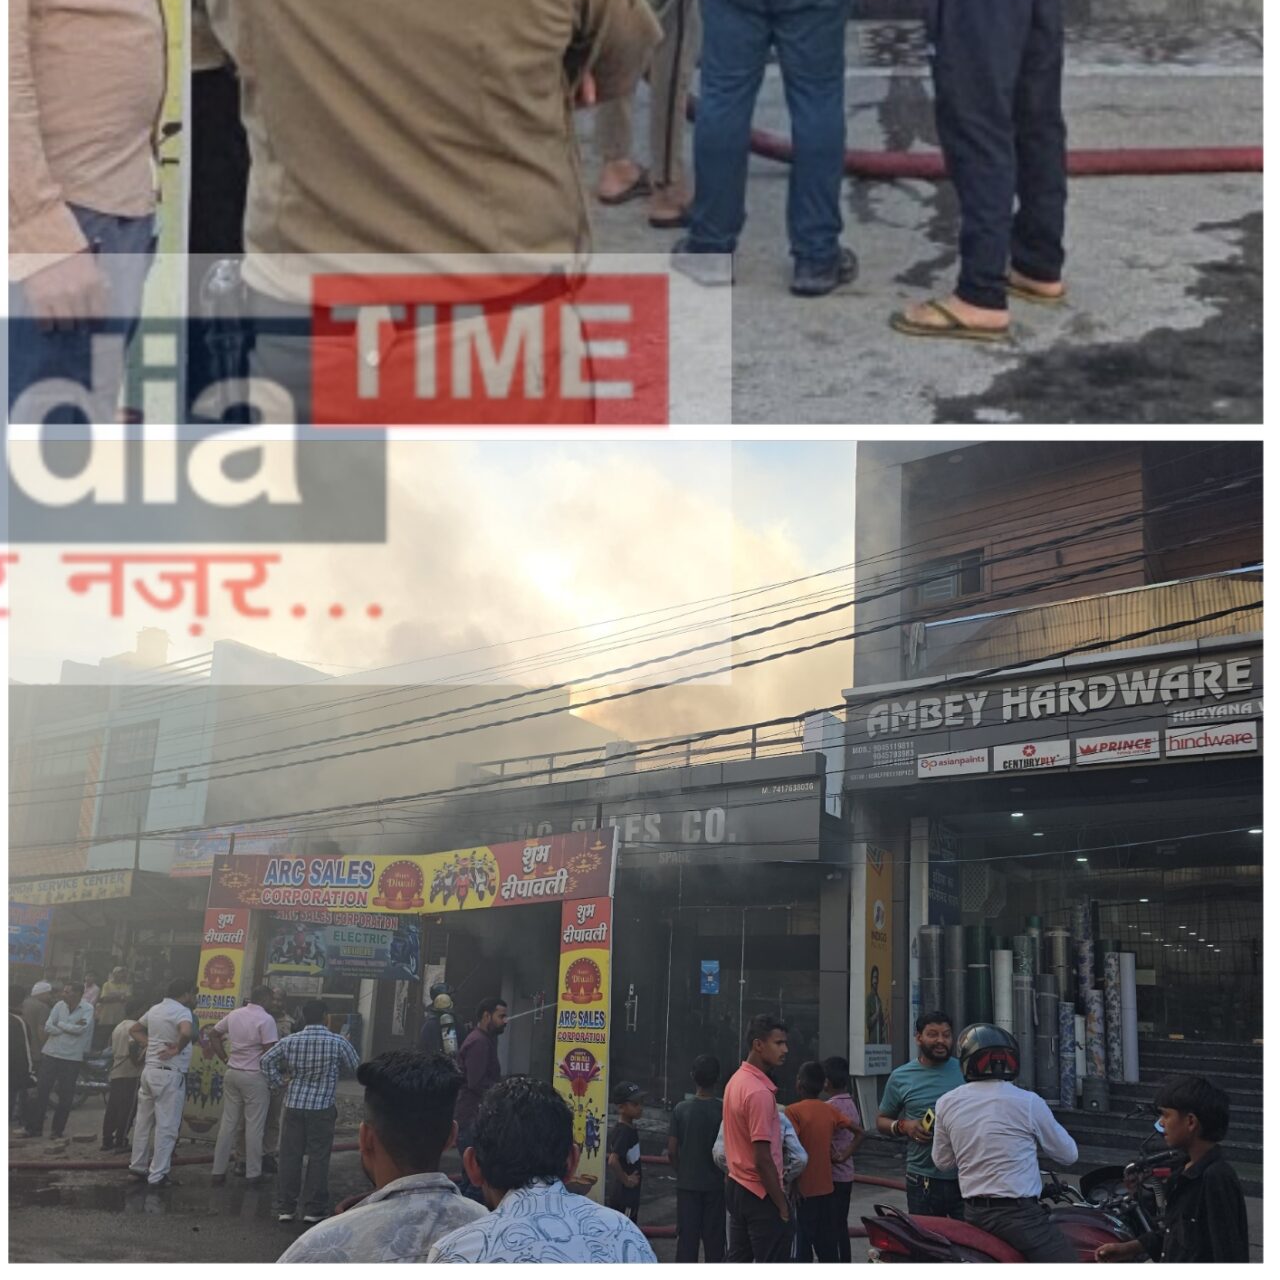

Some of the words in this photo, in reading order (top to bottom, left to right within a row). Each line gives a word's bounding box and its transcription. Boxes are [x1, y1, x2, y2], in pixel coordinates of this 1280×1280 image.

[866, 689, 989, 739] AMBEY
[1002, 657, 1254, 725] HARDWARE
[1172, 703, 1253, 722] HARYANA
[1099, 738, 1152, 755] PRINCE
[1169, 732, 1253, 752] hindware
[938, 755, 985, 767] asianpaints
[1003, 756, 1057, 769] CENTURYPLY
[682, 807, 736, 844] CO.
[522, 844, 551, 873] शुभ
[263, 858, 306, 887] ARC
[308, 858, 375, 888] SALES
[387, 877, 417, 889] Diwali
[501, 868, 569, 900] दीपावली
[261, 888, 369, 909] CORPORATION
[217, 913, 236, 929] शुभ
[334, 911, 399, 931] CORPORATION
[577, 903, 596, 924] शुभ
[205, 928, 244, 944] दीपावली
[333, 930, 387, 945] ELECTRIC
[563, 922, 608, 943] दीपावली
[213, 994, 236, 1009] SALES
[559, 1010, 577, 1028] ARC
[578, 1010, 606, 1029] SALES
[558, 1031, 607, 1043] CORPORATION
[570, 1062, 590, 1072] SALE
